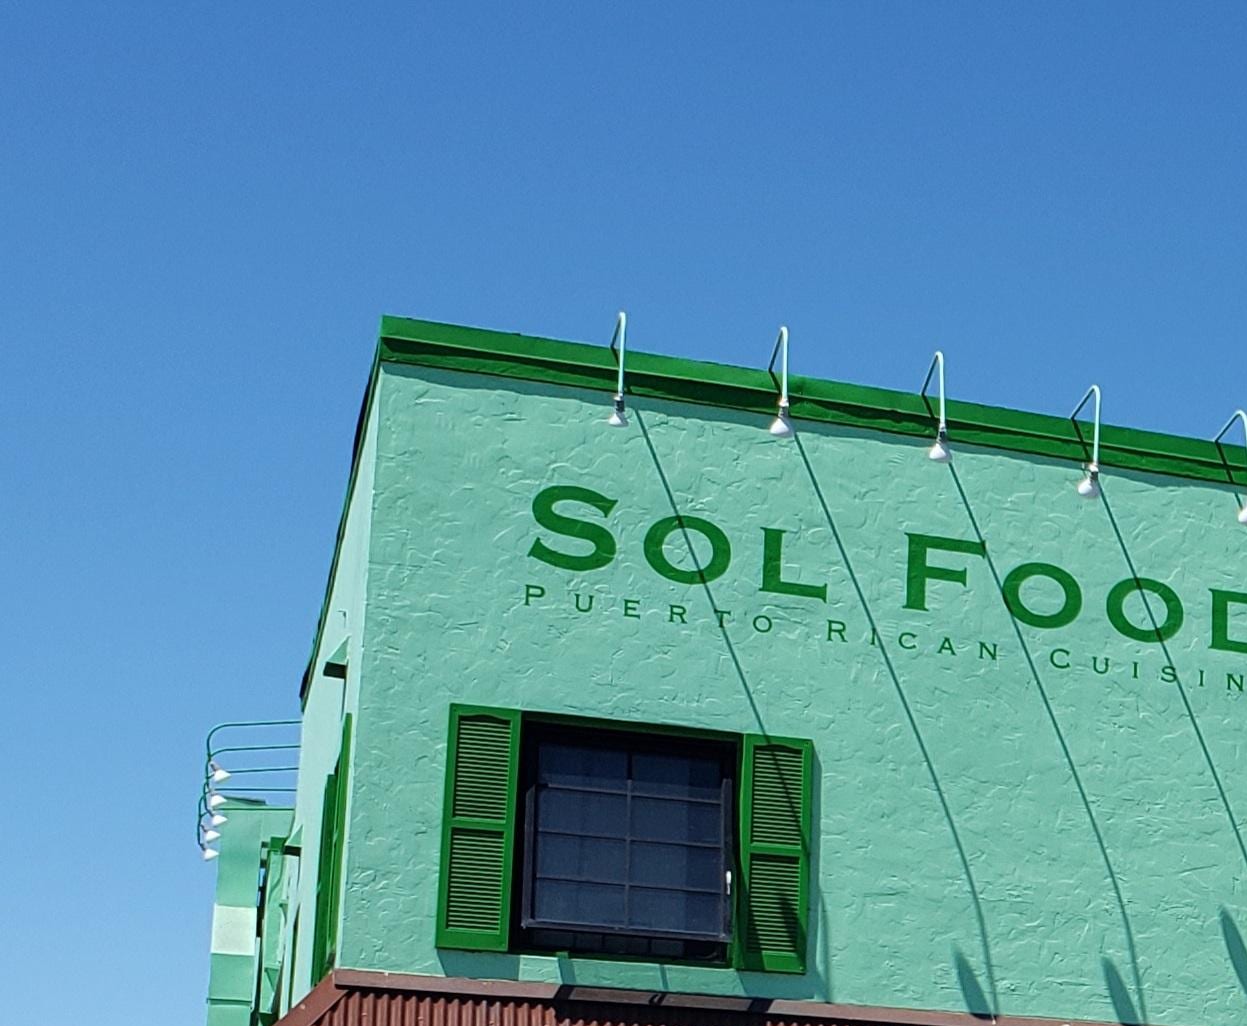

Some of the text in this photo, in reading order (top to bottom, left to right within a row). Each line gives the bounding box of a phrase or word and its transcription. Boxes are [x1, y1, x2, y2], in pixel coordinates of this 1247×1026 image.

[526, 484, 828, 600] SOL
[524, 584, 774, 634] PUERTO
[826, 620, 999, 662] RICAN
